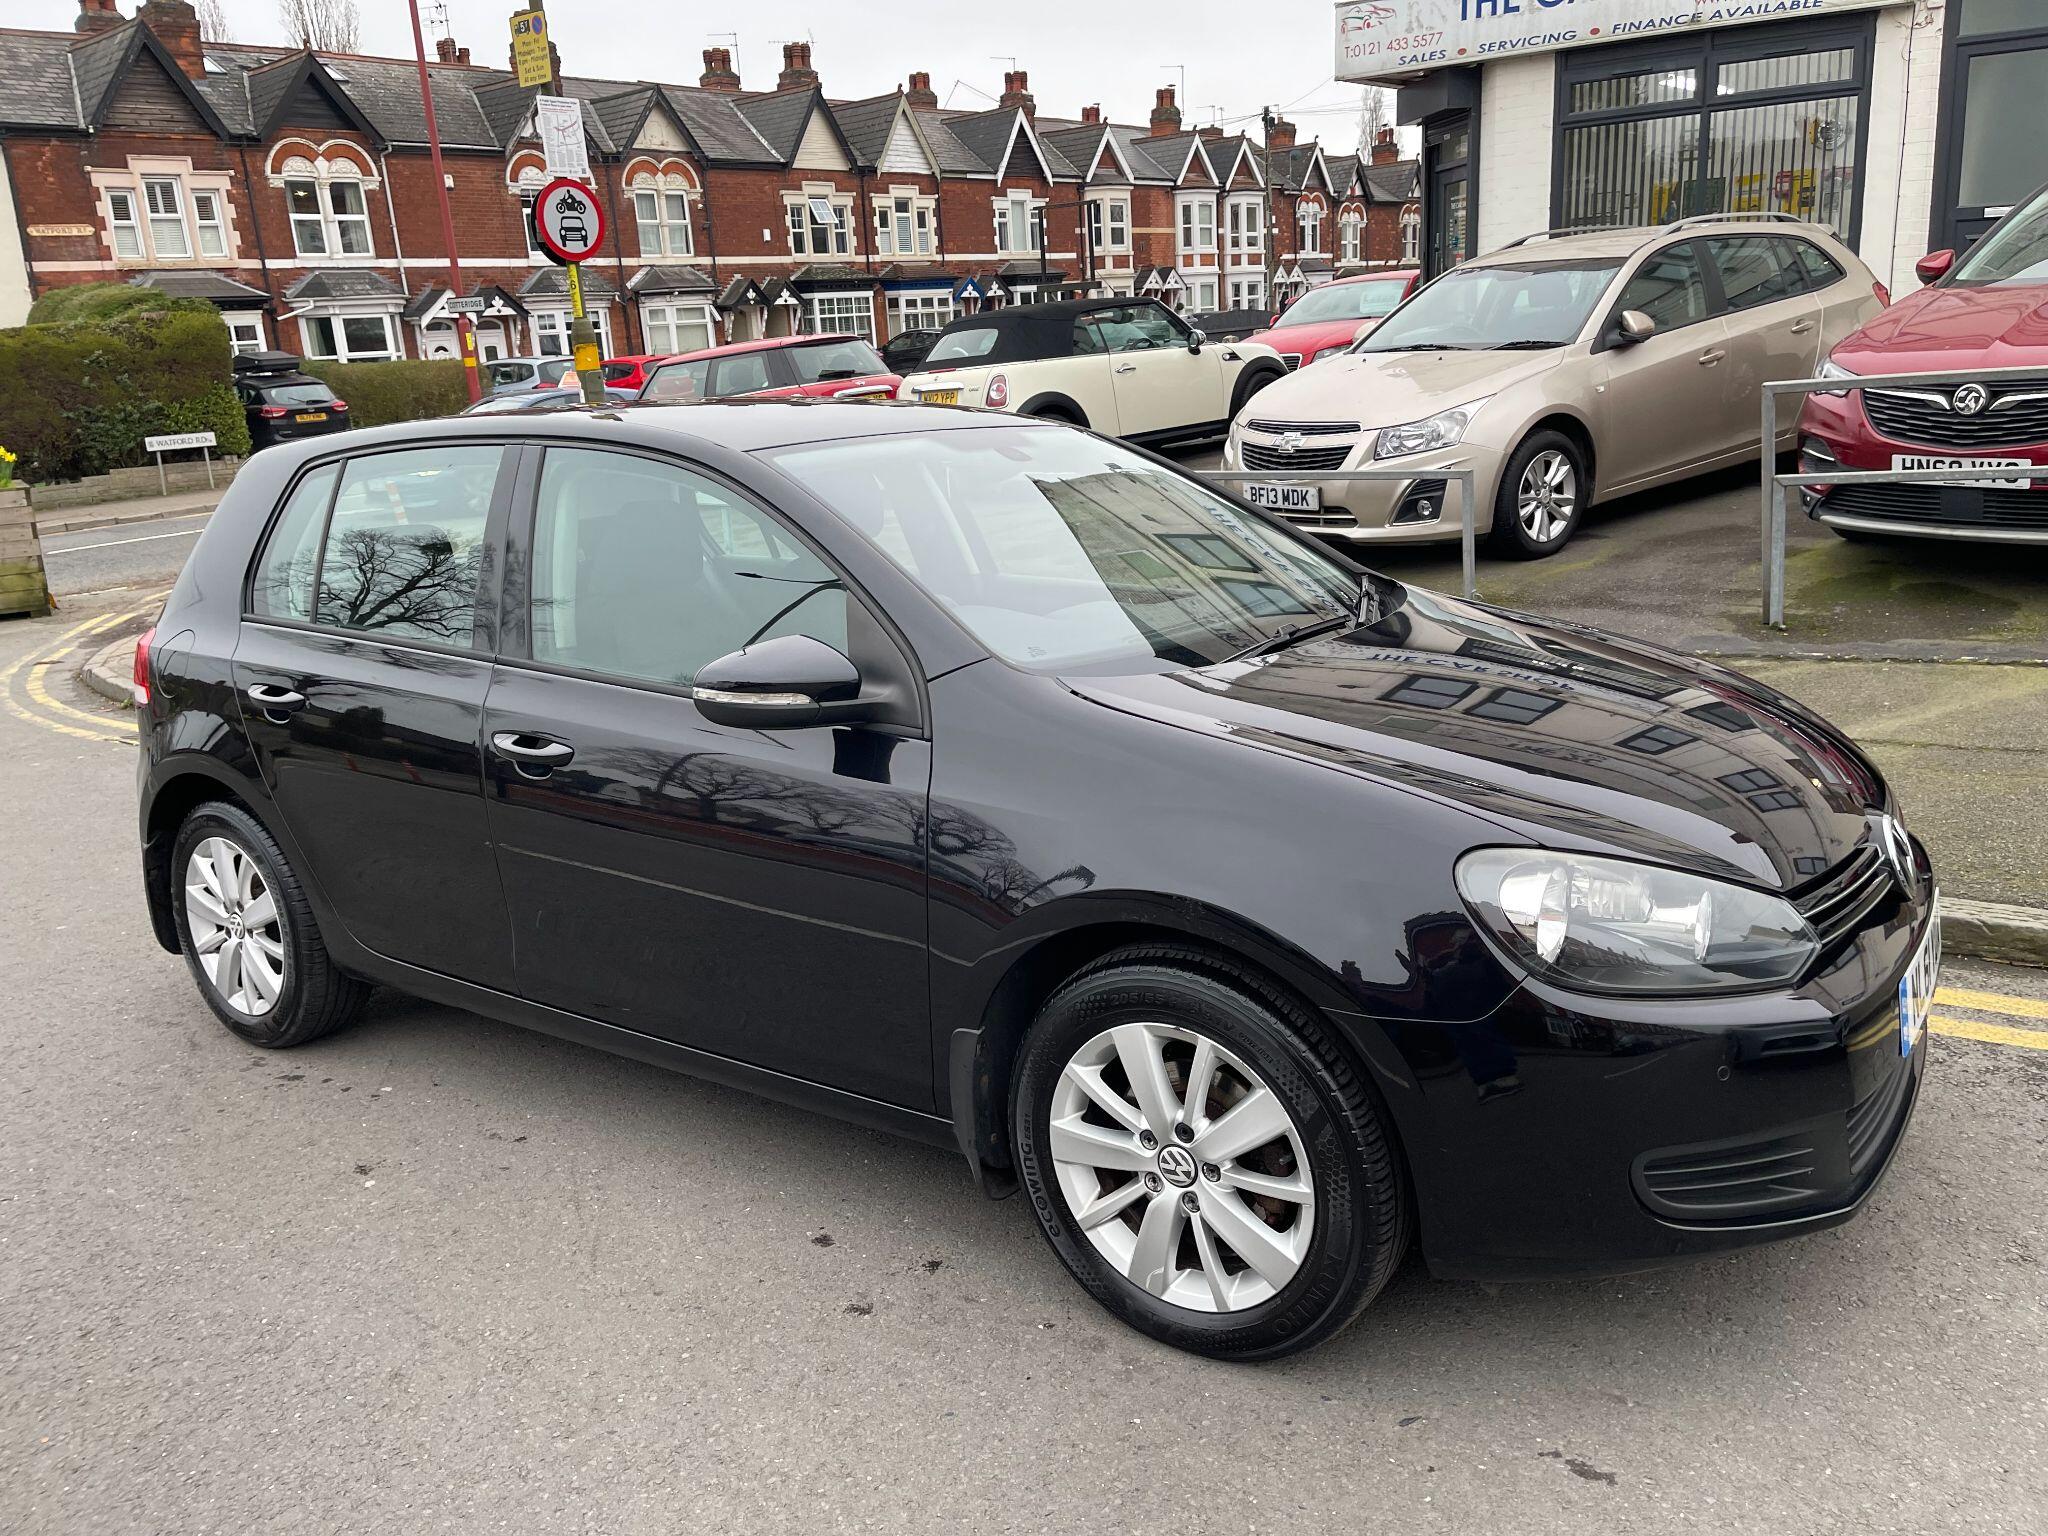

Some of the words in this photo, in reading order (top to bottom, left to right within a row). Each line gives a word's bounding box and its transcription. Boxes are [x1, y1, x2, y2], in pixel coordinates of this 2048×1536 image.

[1345, 41, 1382, 59] T:0121
[1386, 37, 1408, 52] 433
[1412, 31, 1444, 48] 5577
[1398, 49, 1447, 66] SALES
[1477, 30, 1577, 54] SERVICING
[1611, 12, 1703, 34] FINANCE
[1709, 0, 1823, 21] AVAILABLE
[155, 437, 194, 447] WATFORD
[1249, 486, 1278, 505] BF13
[1281, 488, 1309, 507] MDK
